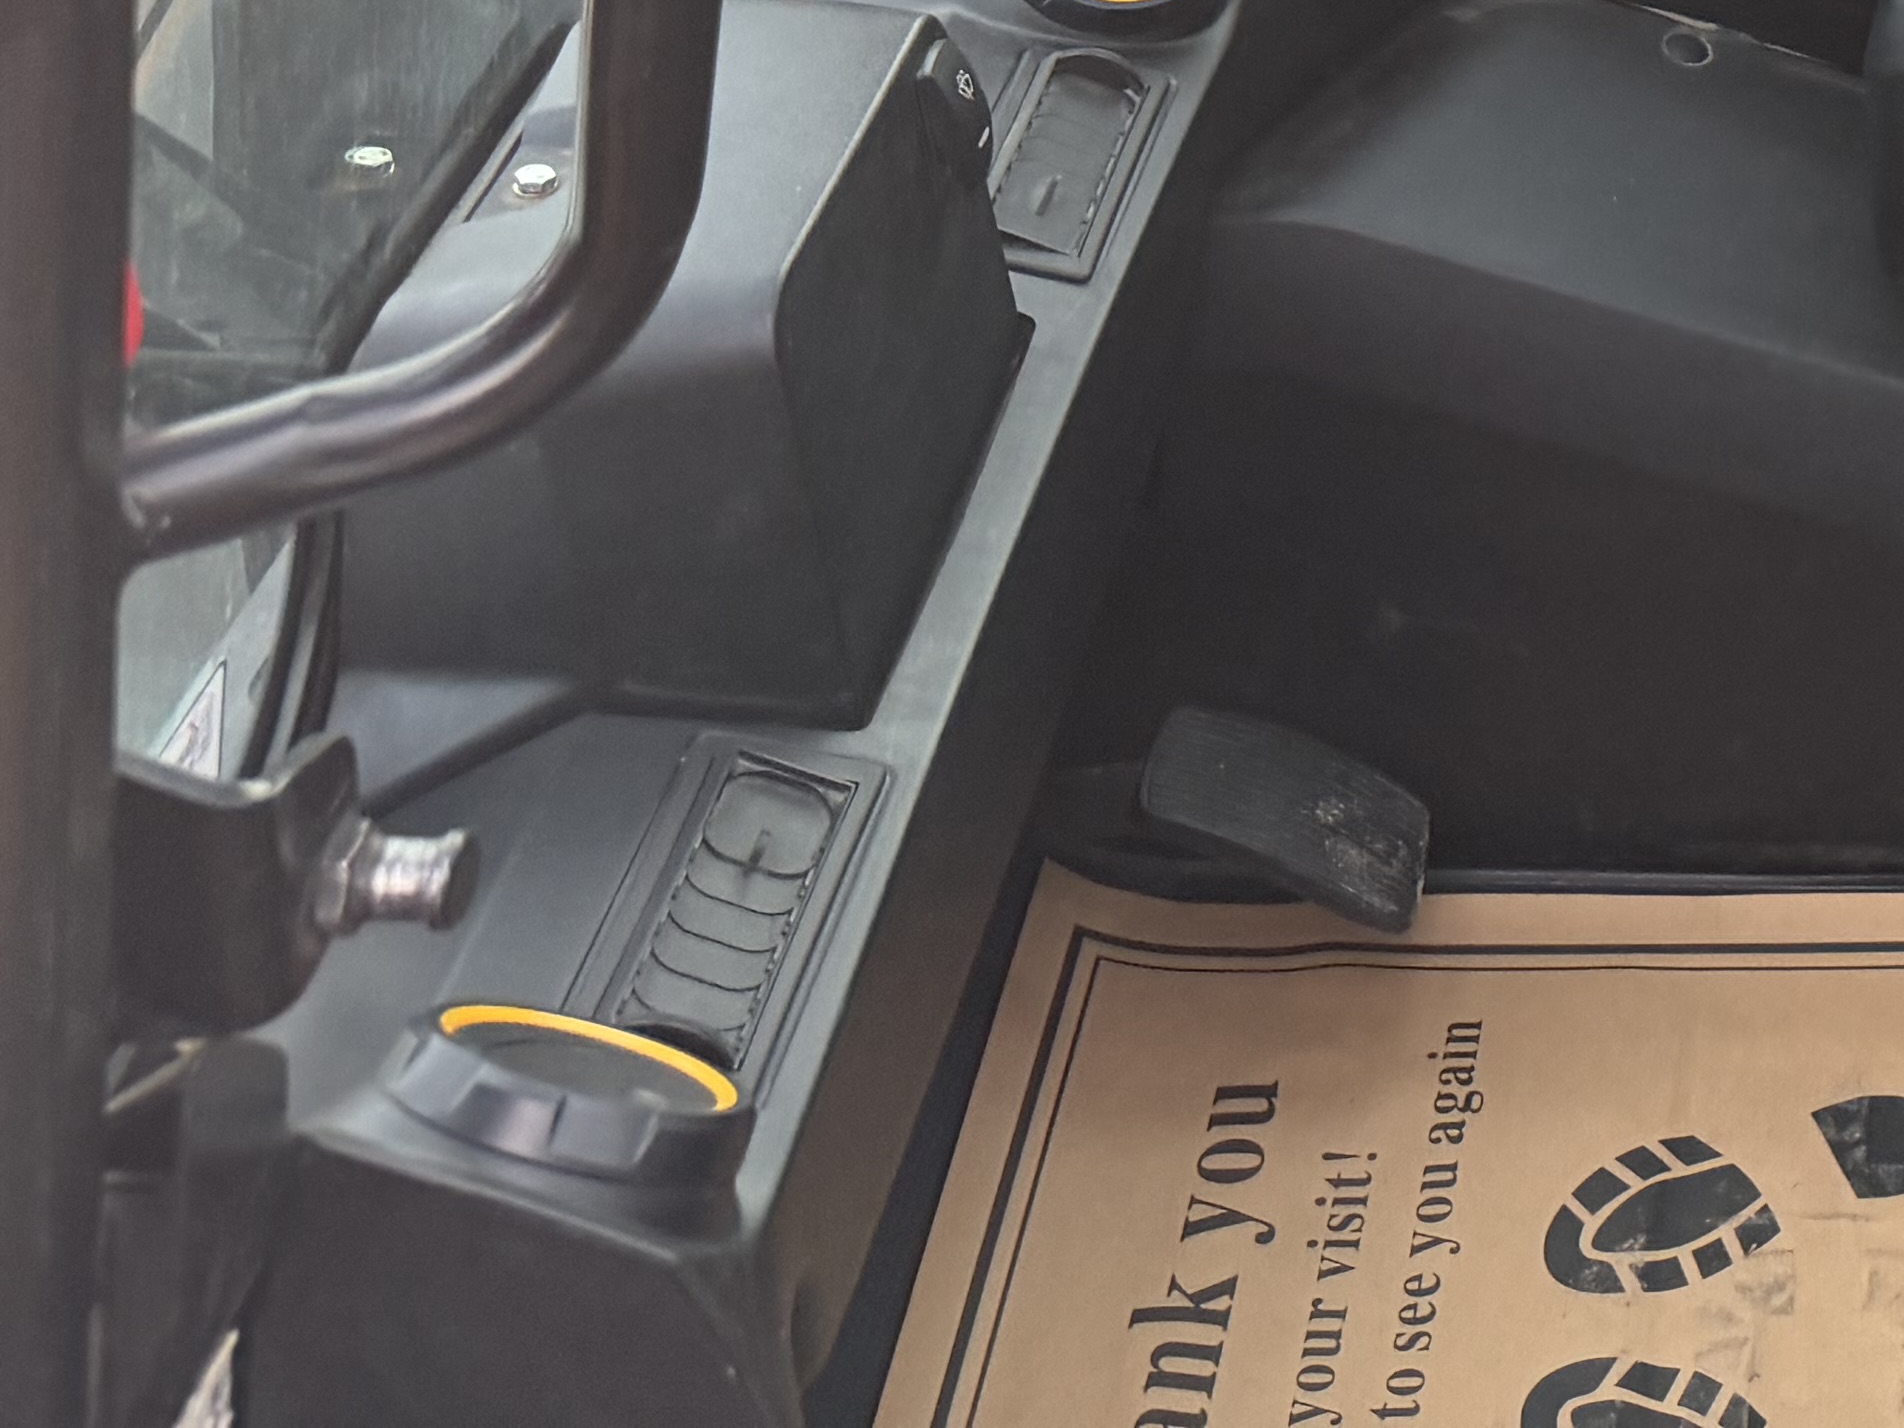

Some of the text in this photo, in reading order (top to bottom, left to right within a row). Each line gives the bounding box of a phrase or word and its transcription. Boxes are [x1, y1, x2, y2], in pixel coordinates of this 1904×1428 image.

[1180, 1080, 1278, 1244] you
[1288, 1151, 1377, 1427] your visit!
[1370, 1019, 1484, 1420] to see you again
